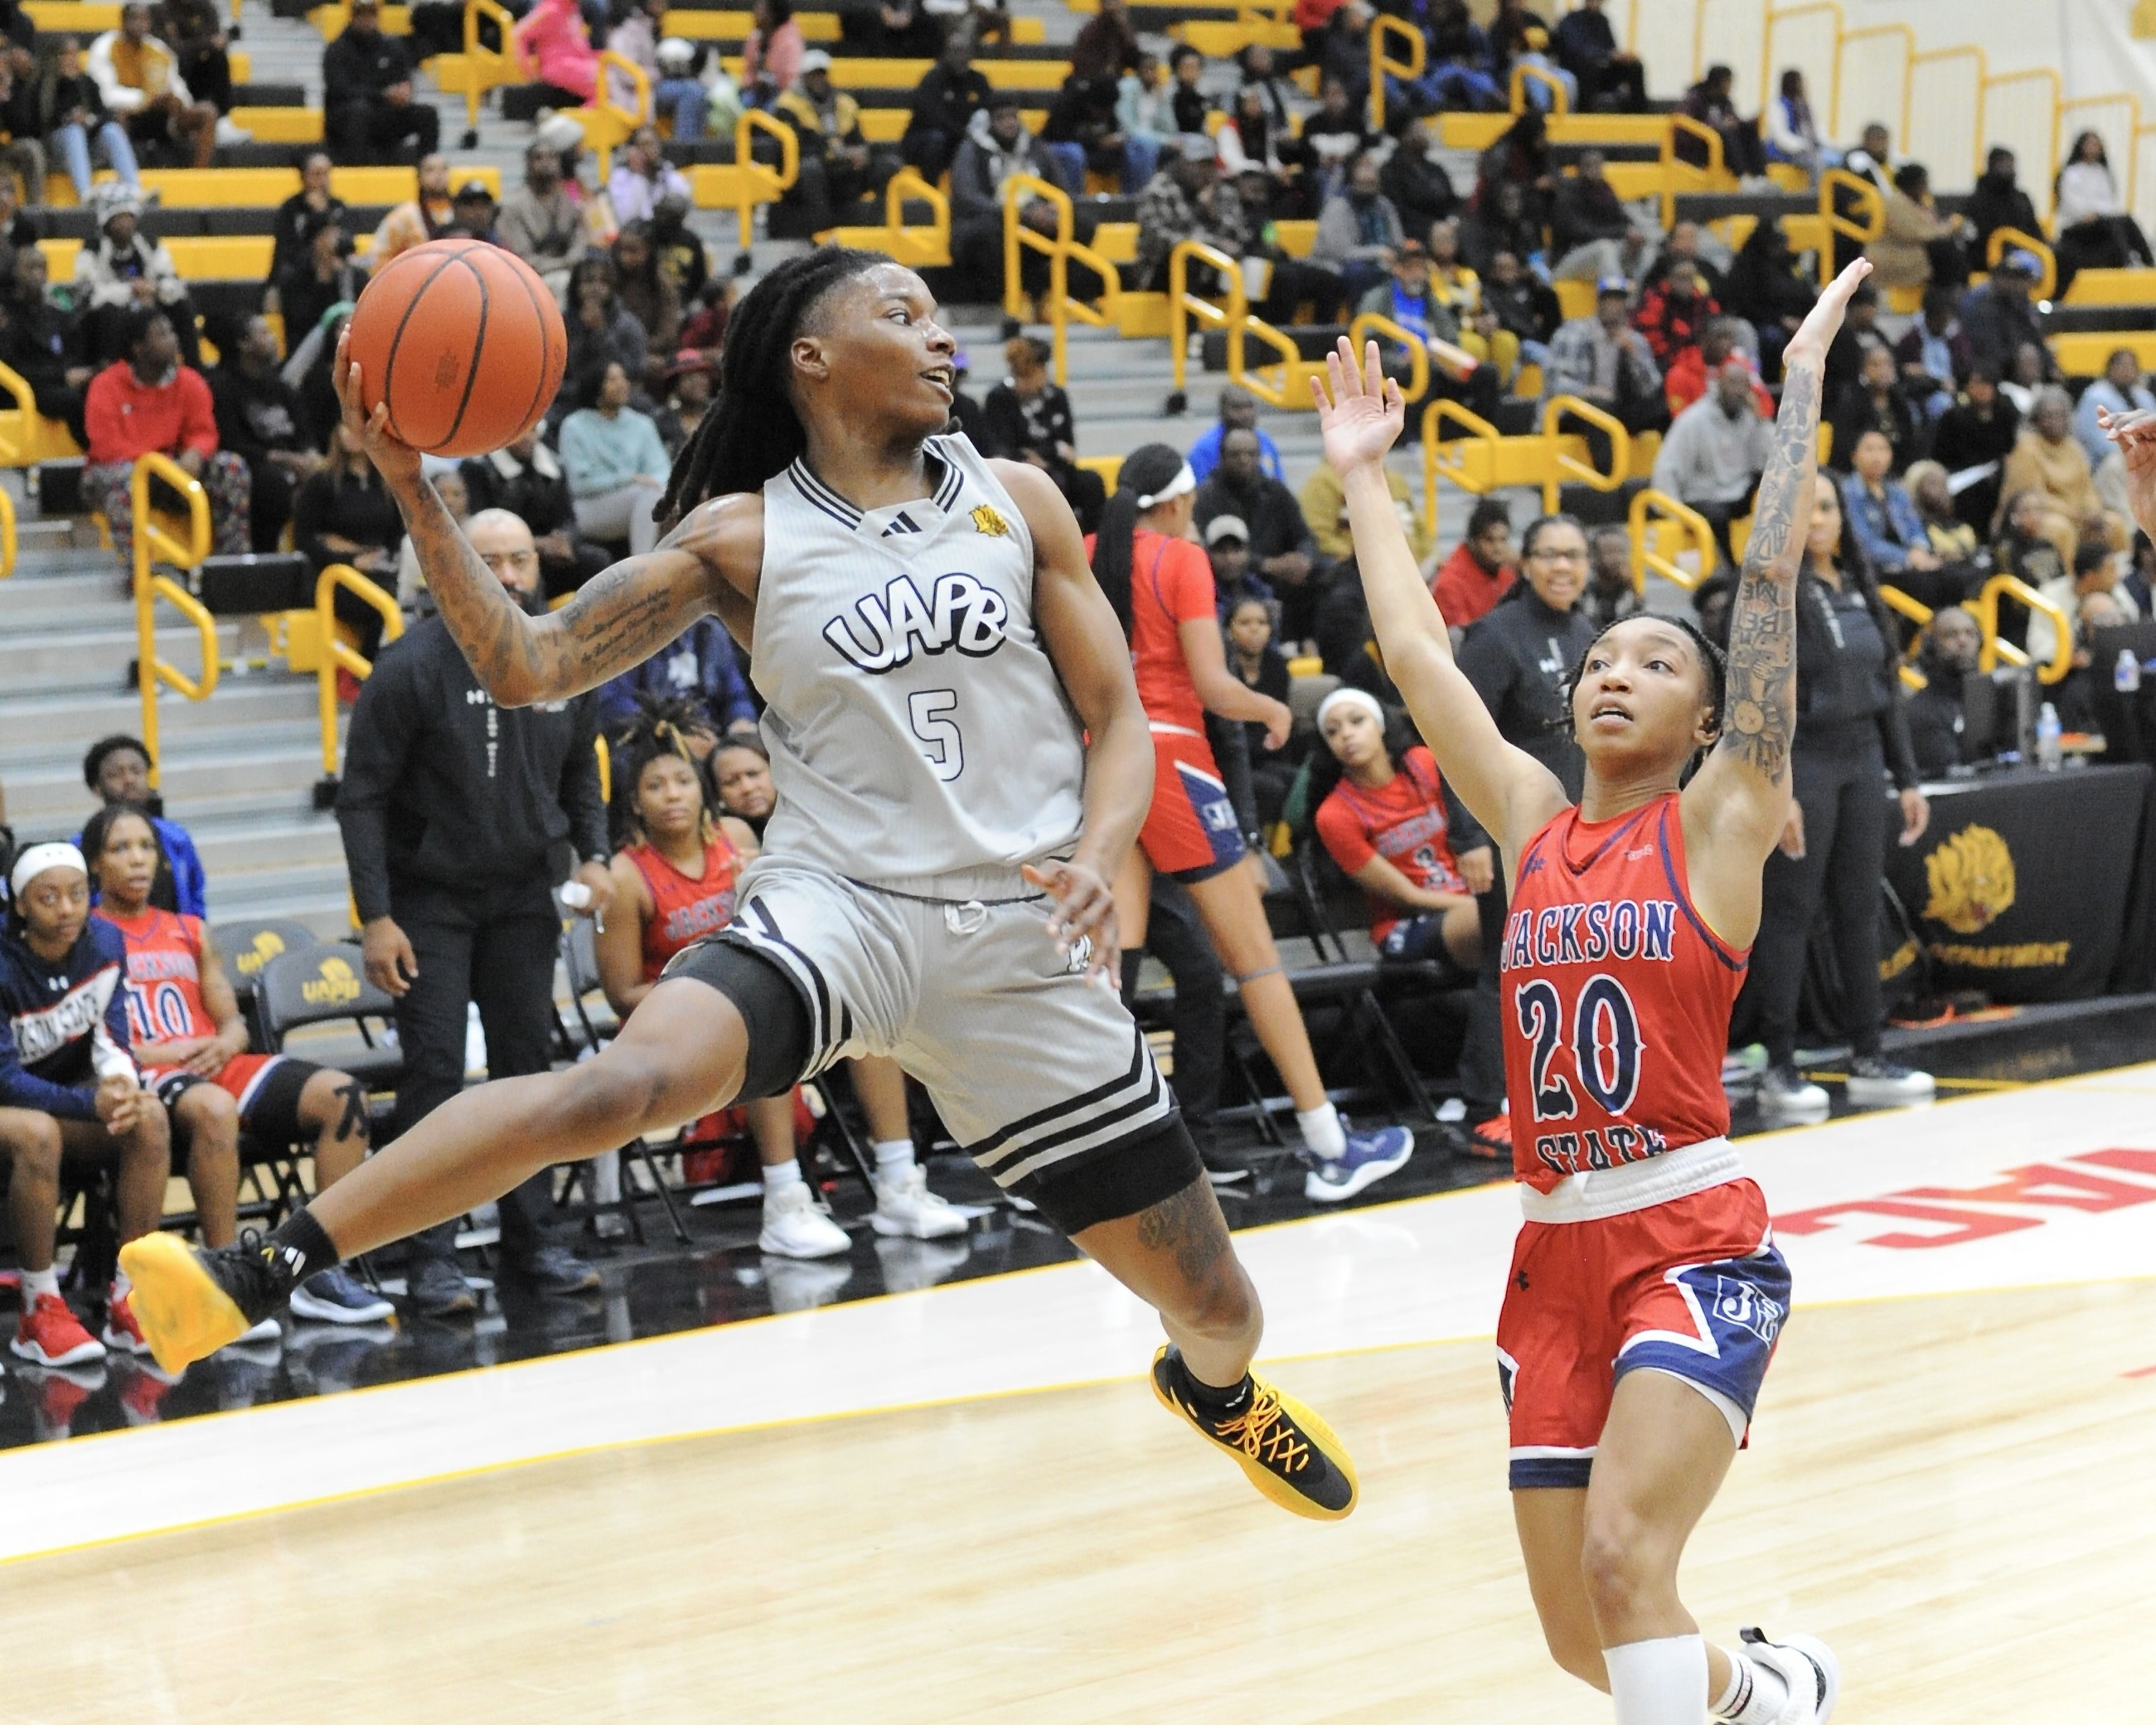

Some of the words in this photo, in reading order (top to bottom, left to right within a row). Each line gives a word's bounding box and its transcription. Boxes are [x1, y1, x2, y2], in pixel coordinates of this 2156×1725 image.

[823, 572, 1008, 675] UAPB
[908, 689, 964, 782] 5
[123, 979, 196, 1039] 10
[1515, 973, 1647, 1122] 20
